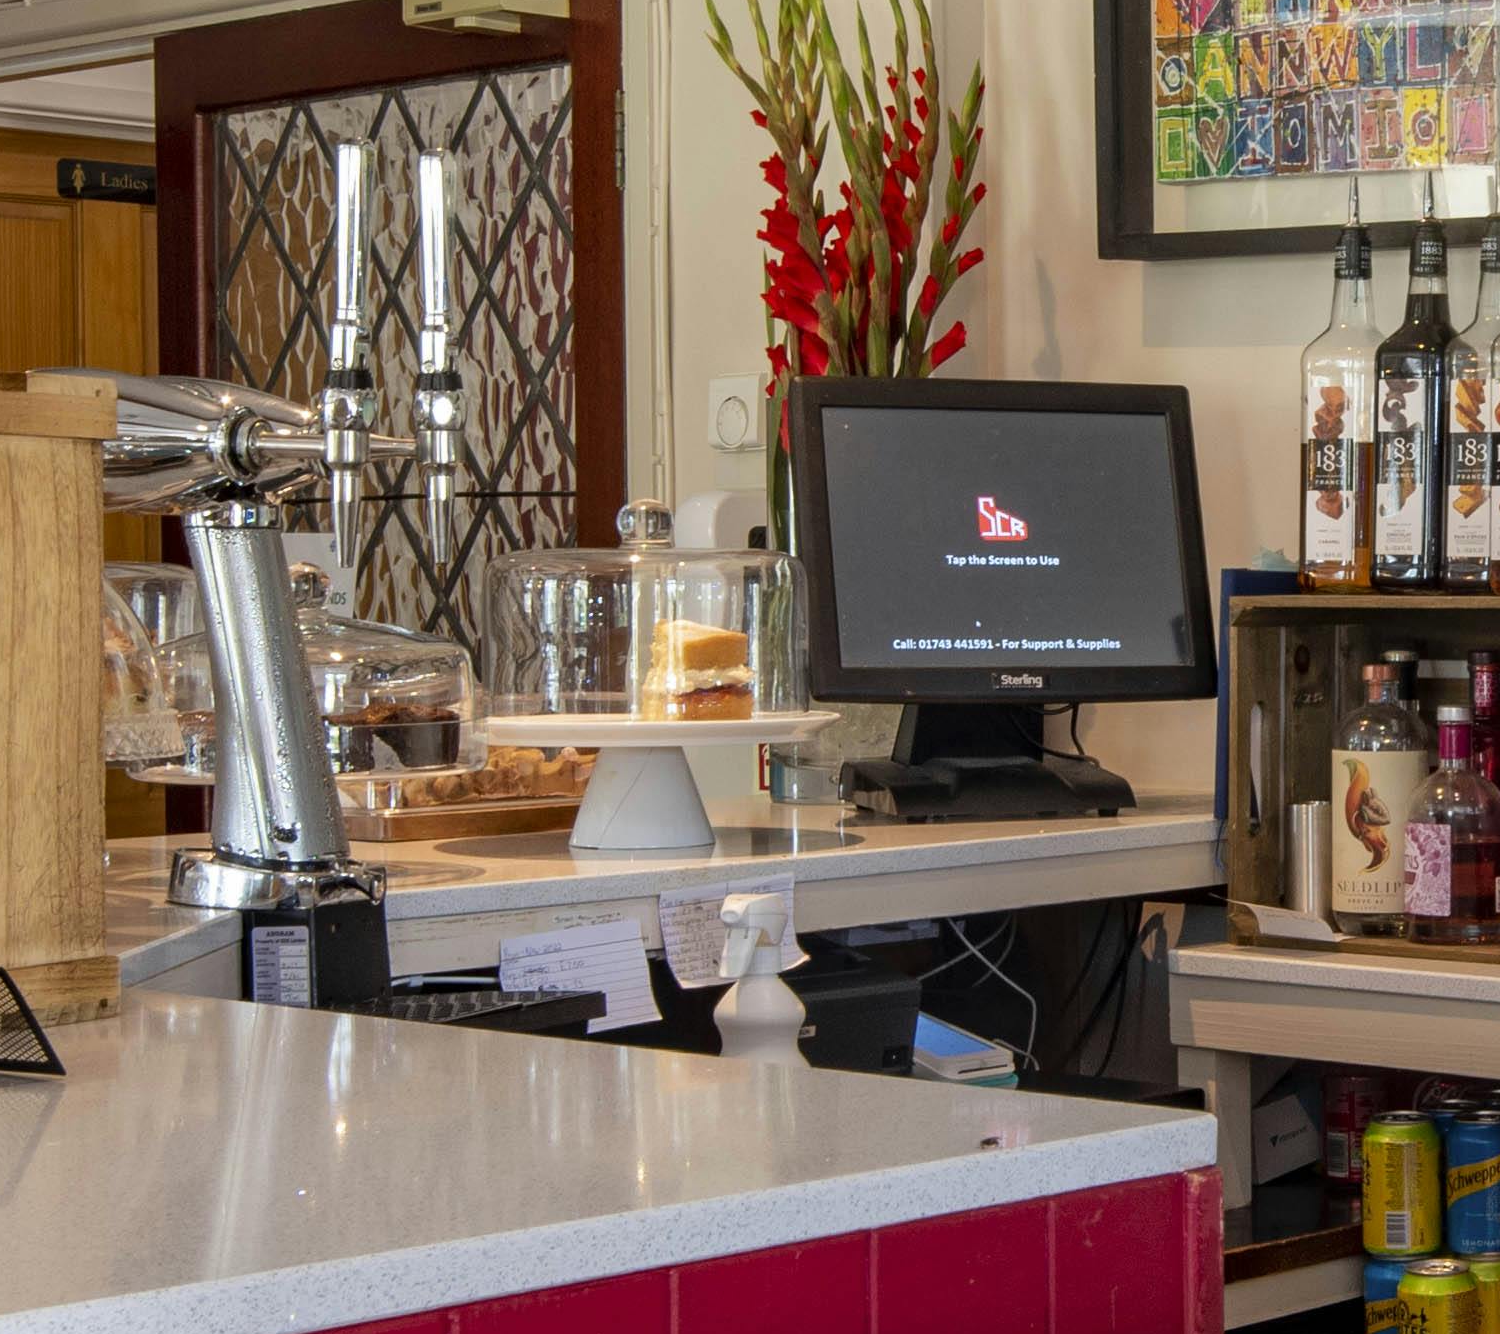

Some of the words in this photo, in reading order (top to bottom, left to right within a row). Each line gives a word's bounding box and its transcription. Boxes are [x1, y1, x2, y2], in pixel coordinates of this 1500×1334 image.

[1199, 21, 1441, 99] ANNWYL
[1421, 246, 1443, 255] 1883
[1316, 444, 1345, 472] 1883
[1386, 438, 1416, 465] 1883
[1458, 438, 1487, 466] 1883
[946, 555, 966, 566] Tap
[969, 555, 986, 565] the
[988, 555, 1023, 566] Screen
[1026, 556, 1037, 565] to
[1039, 556, 1059, 566] Use
[893, 639, 916, 649] Call:
[919, 639, 952, 649] 01743
[954, 639, 993, 649] 441591
[1002, 639, 1019, 649] For
[1021, 639, 1063, 651] Support
[1066, 639, 1075, 649] &
[1077, 639, 1121, 651] Supplies
[1000, 674, 1043, 688] Sterling
[1337, 881, 1400, 893] SEEDLIP
